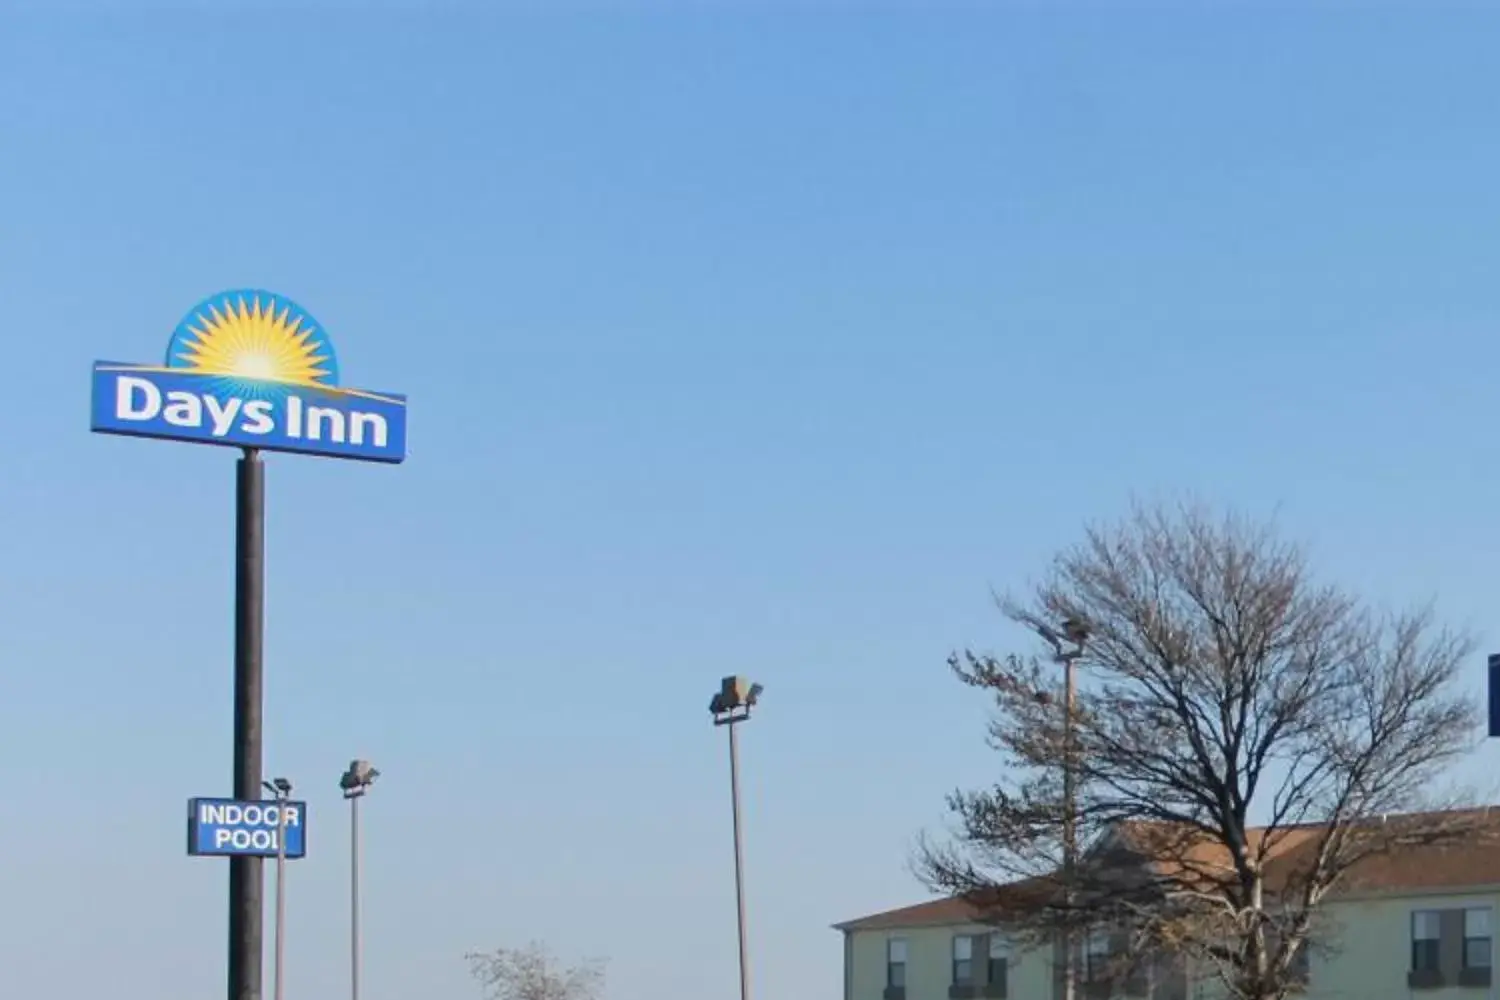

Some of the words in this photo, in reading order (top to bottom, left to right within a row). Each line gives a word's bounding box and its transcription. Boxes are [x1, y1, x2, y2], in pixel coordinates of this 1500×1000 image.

[116, 375, 274, 437] Days
[286, 395, 388, 447] Inn
[201, 804, 299, 827] INDOOR
